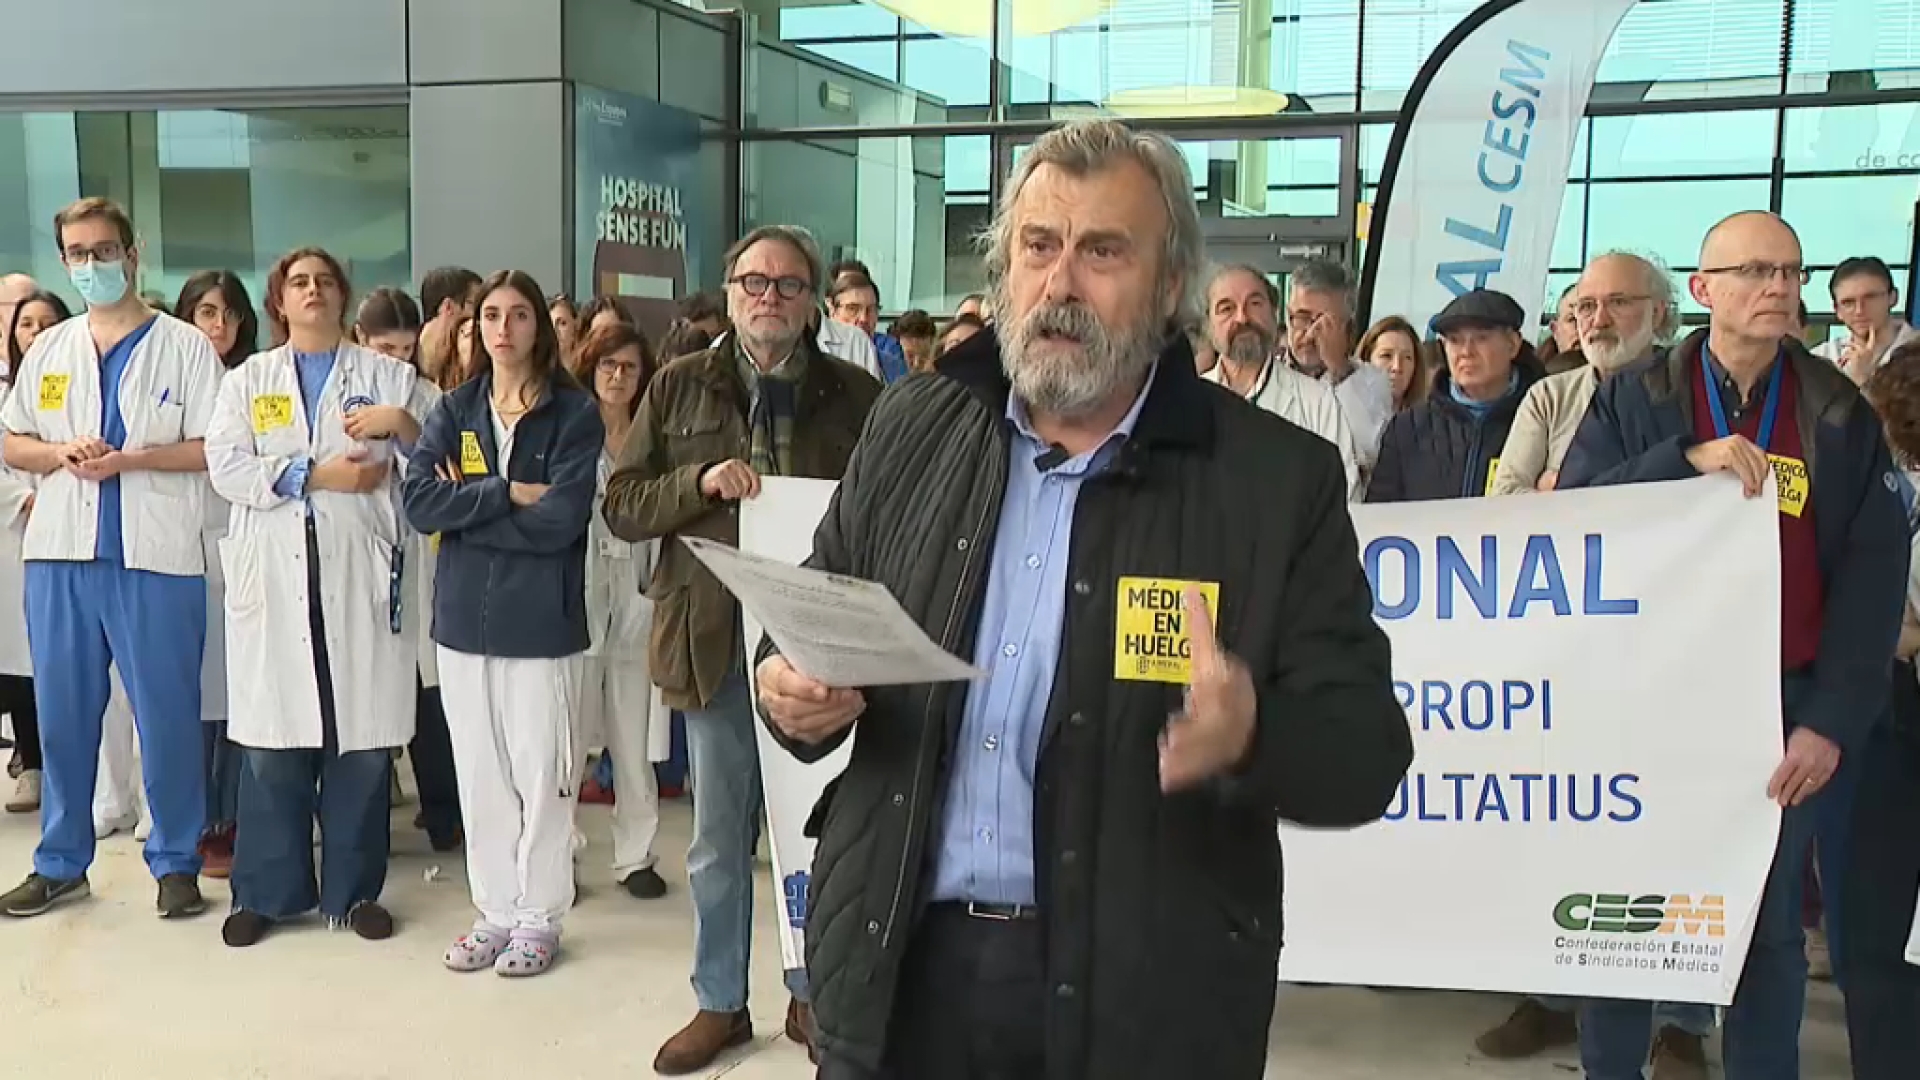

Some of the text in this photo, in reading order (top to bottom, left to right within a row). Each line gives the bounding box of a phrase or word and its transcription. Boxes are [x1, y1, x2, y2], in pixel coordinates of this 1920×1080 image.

[1477, 39, 1550, 193] CESM
[1855, 147, 1886, 168] de
[601, 173, 682, 217] HOSPITAL
[596, 211, 686, 251] SENSE FUM
[1363, 534, 1639, 619] ONAL
[1128, 581, 1208, 611] MÉDI
[1154, 612, 1181, 634] EN
[1124, 633, 1191, 659] HUELG
[1552, 893, 1726, 936] CESM
[1554, 936, 1724, 957] Confederación Estatal
[1554, 953, 1720, 974] de Sindicatos Médico
